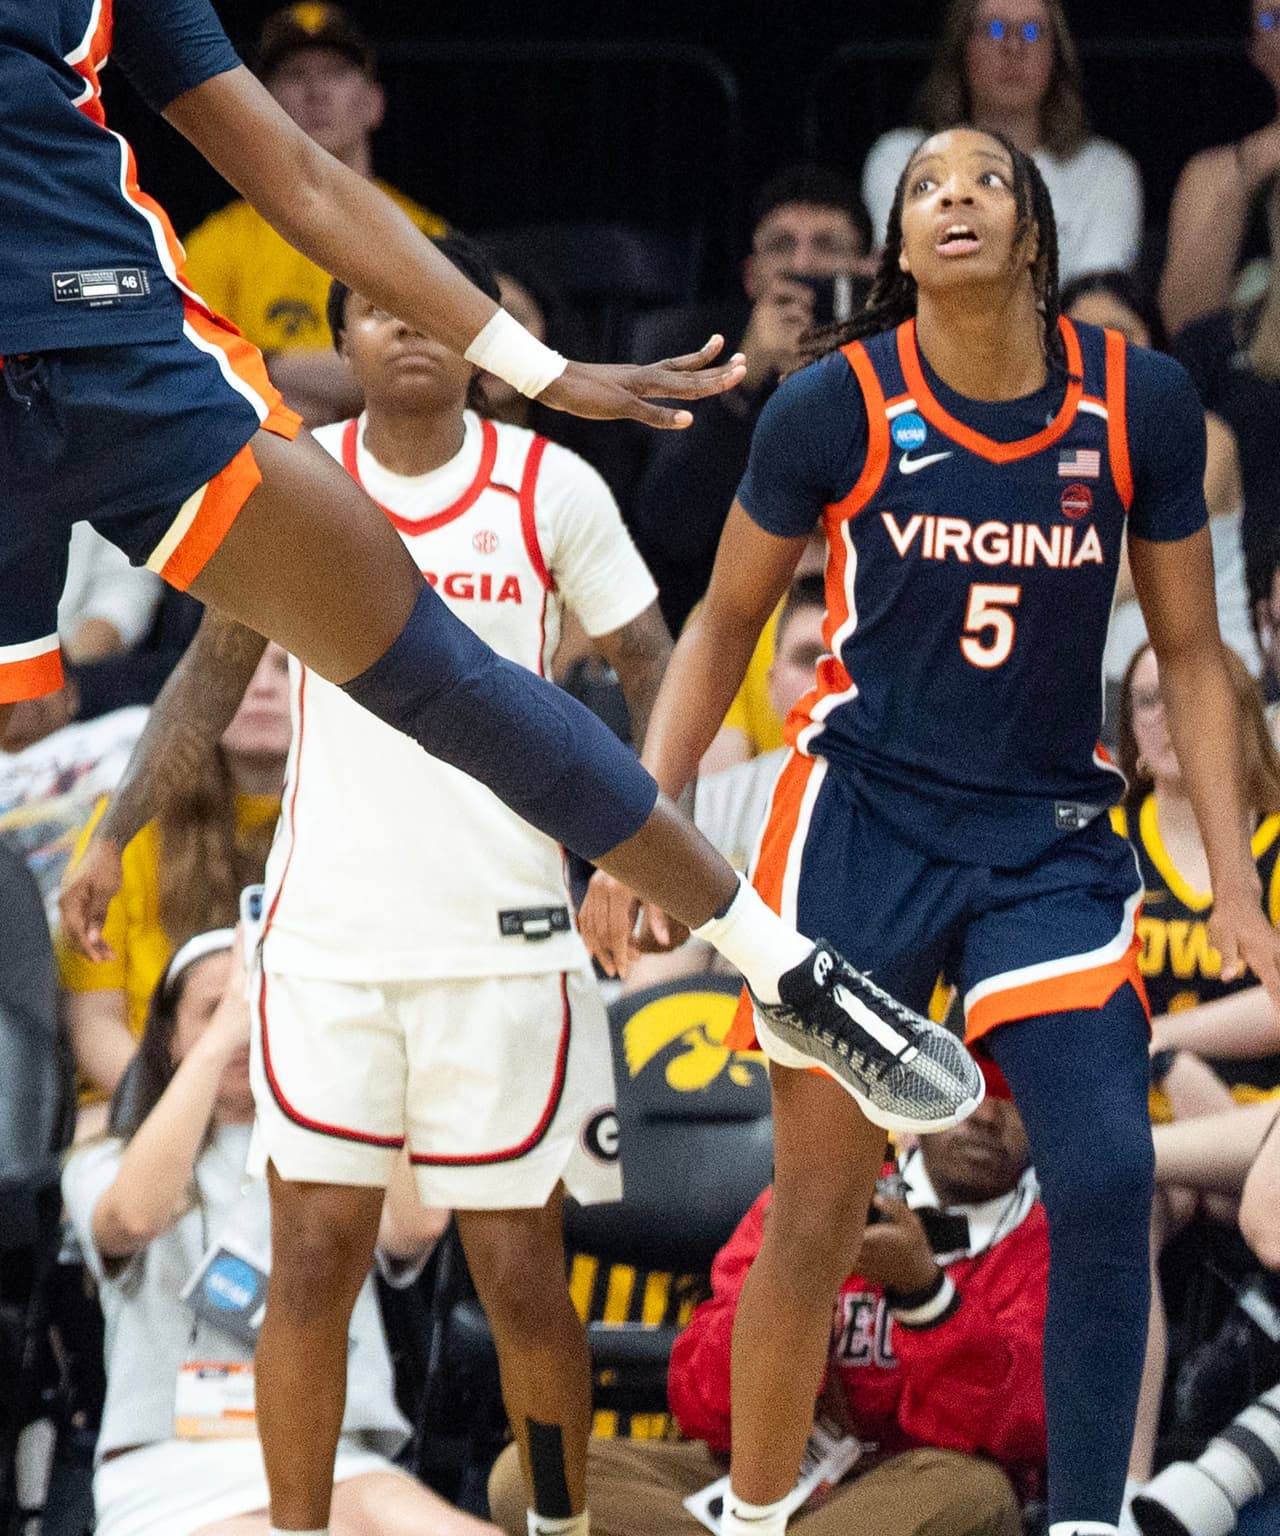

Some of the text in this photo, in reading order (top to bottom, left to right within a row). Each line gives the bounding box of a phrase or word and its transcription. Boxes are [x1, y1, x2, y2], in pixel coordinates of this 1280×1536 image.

[121, 275, 138, 289] 46
[880, 512, 1105, 569] VIRGINIA
[959, 581, 1023, 672] 5
